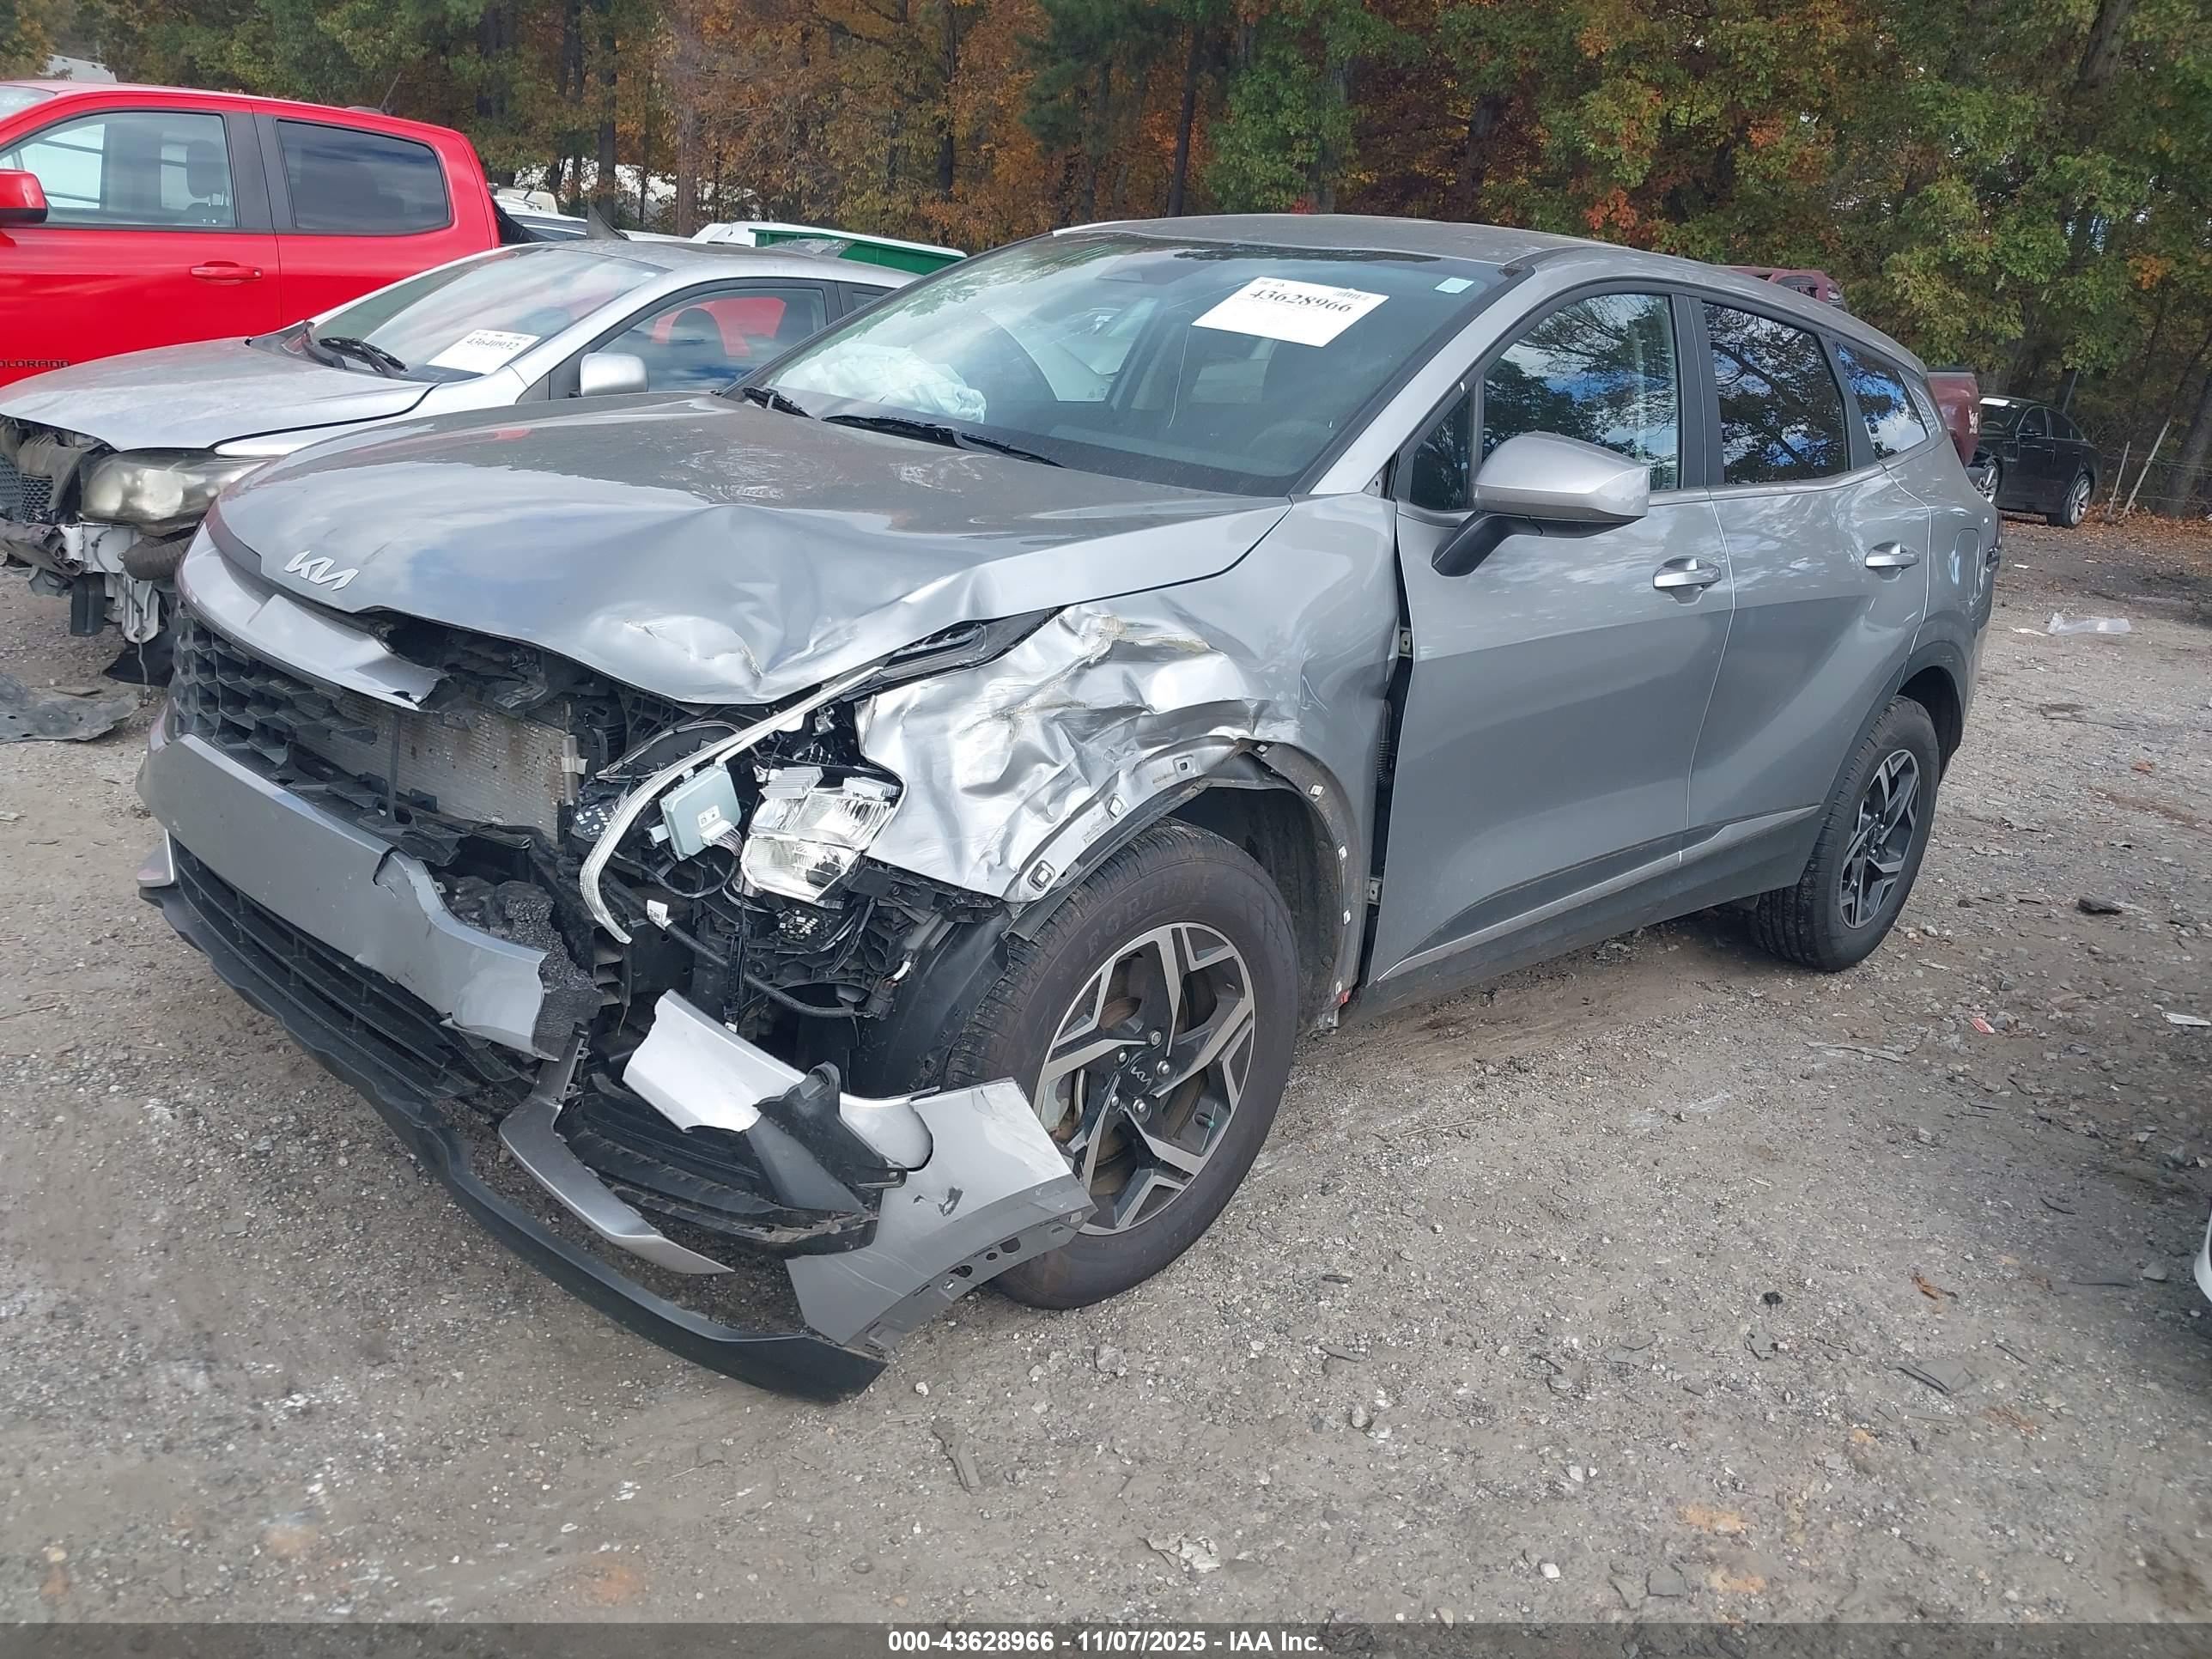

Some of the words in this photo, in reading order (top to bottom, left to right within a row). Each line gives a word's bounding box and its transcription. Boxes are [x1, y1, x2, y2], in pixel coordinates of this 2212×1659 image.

[1250, 289, 1352, 313] 43628966
[284, 550, 359, 591] KIA
[1131, 1066, 1152, 1085] KIA
